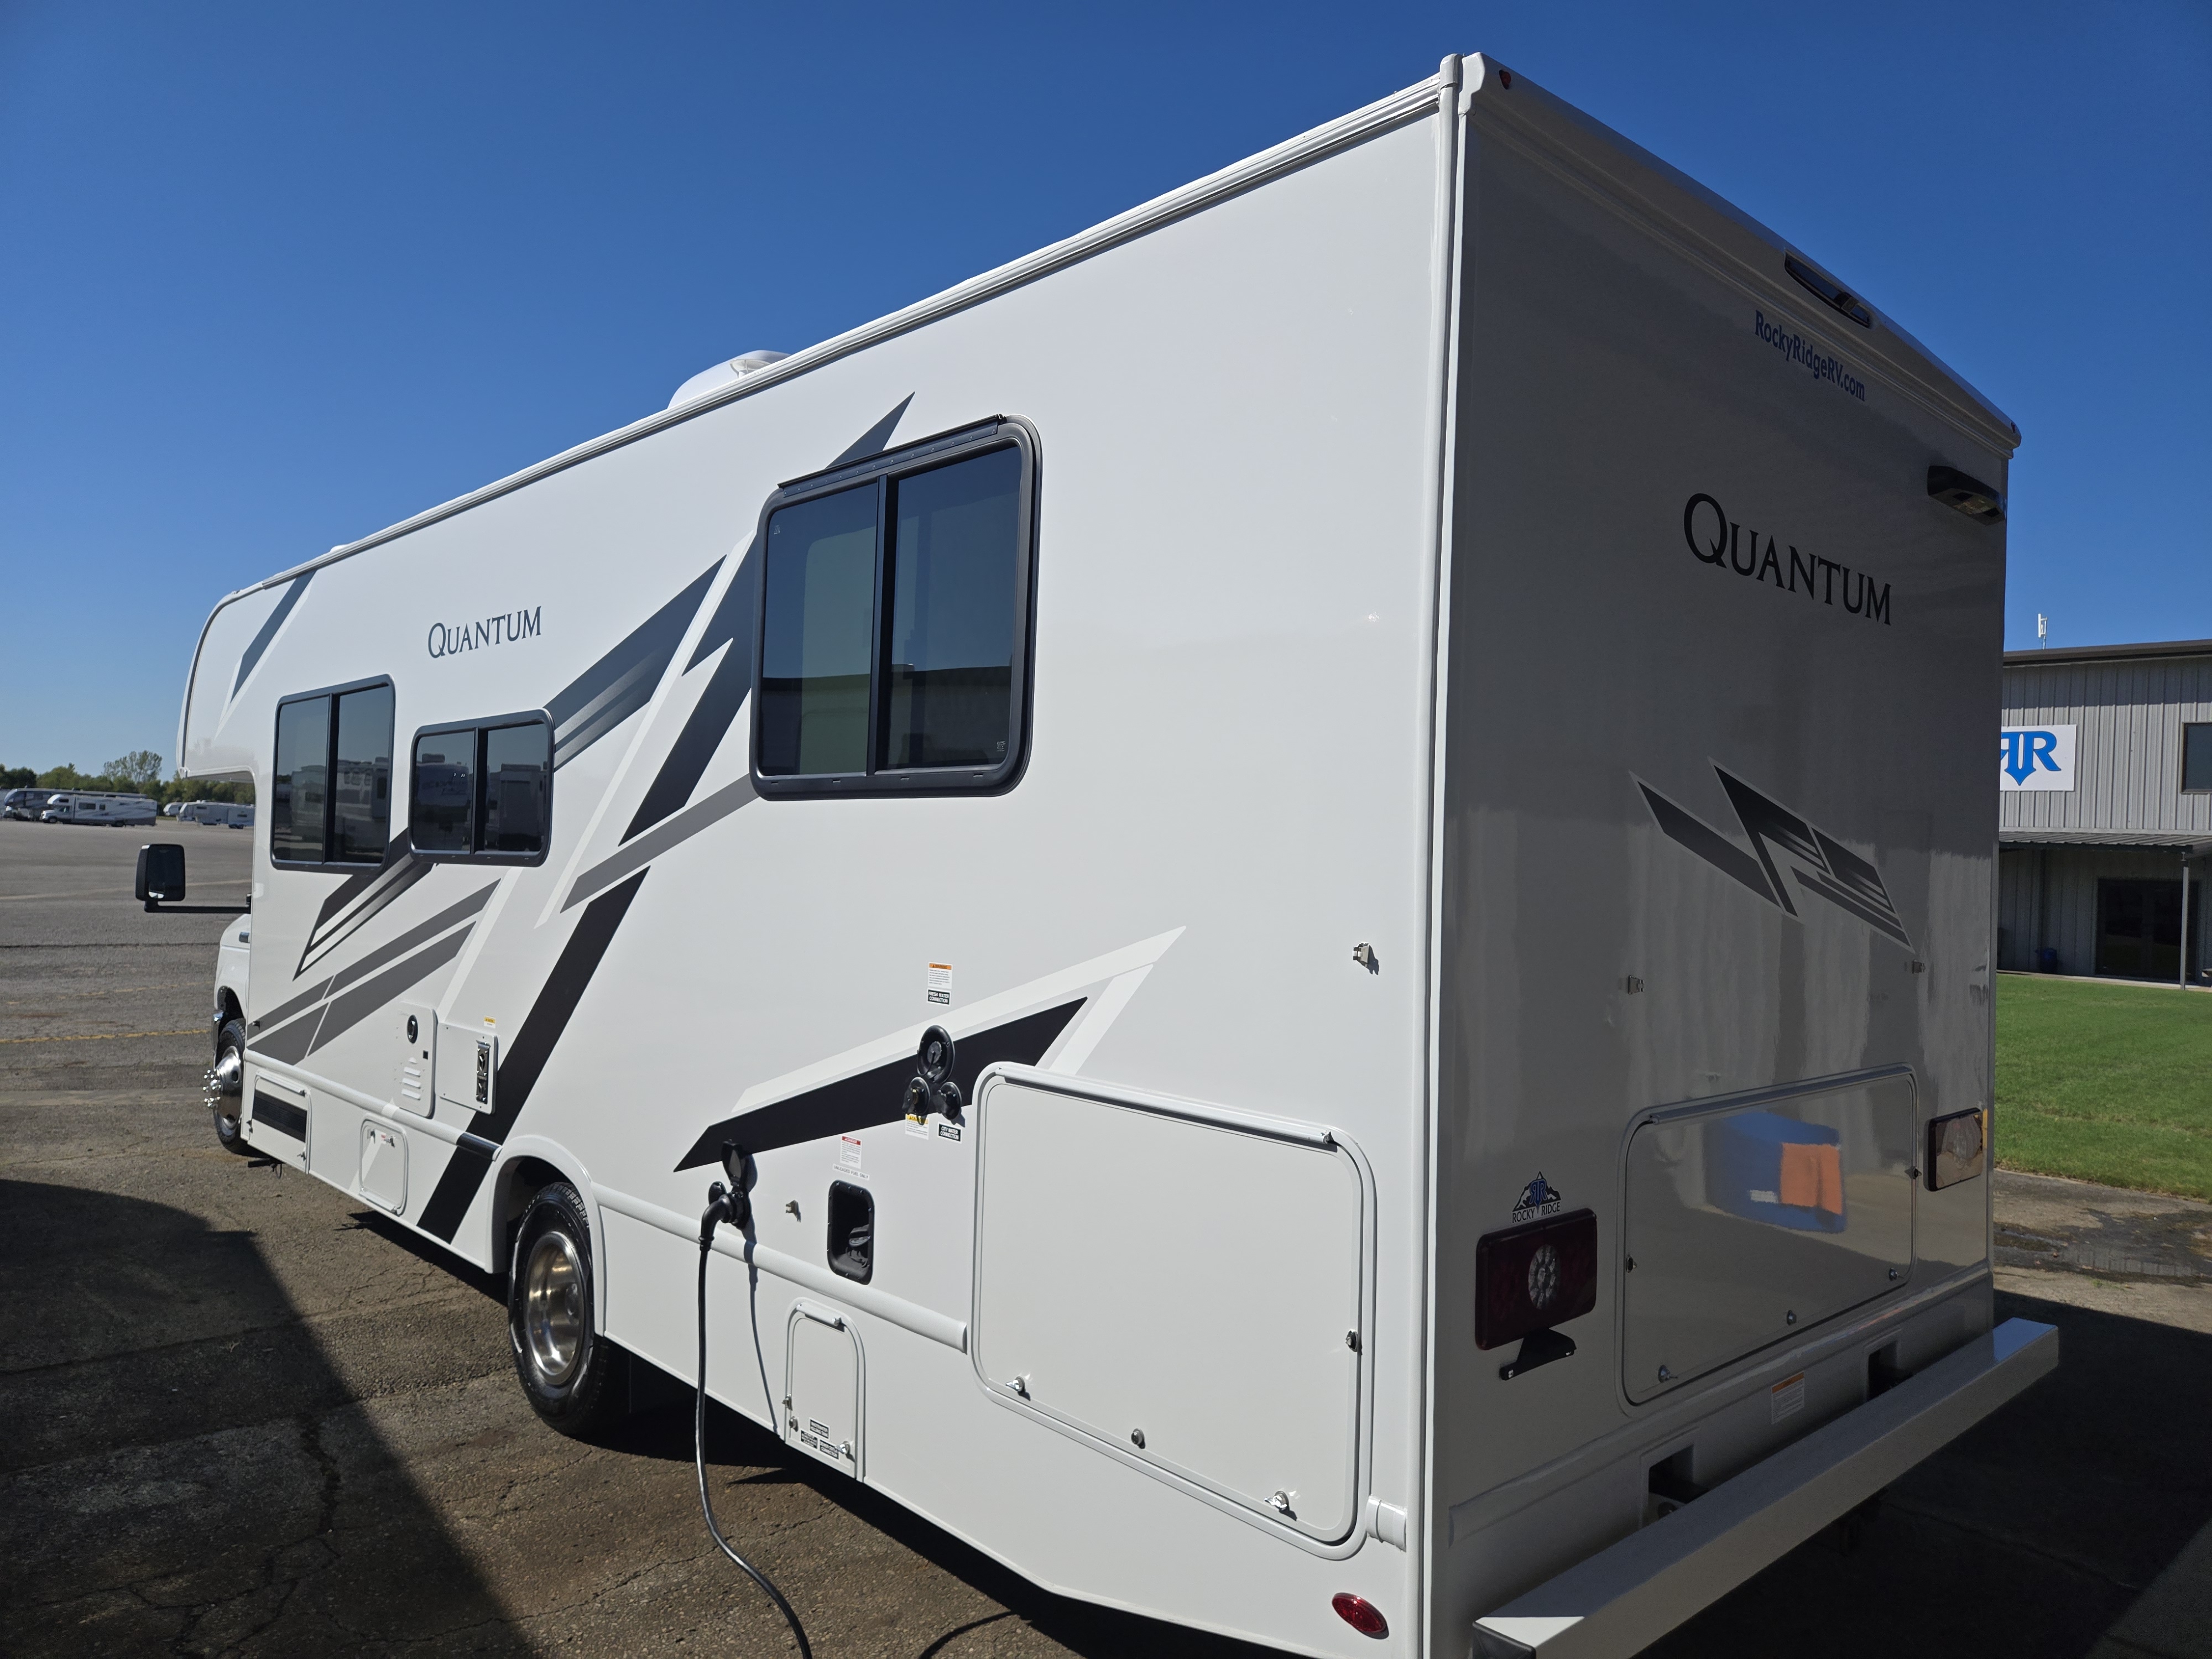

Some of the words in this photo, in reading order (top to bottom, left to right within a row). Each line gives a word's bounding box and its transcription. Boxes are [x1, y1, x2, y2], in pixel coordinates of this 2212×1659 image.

[1755, 310, 1865, 401] RockyRidgeRV.com
[1684, 493, 1891, 626] QUANTUM
[428, 606, 541, 659] QUANTUM
[834, 1165, 851, 1173] UNLEADED
[1512, 1208, 1535, 1223] ROCKY
[1541, 1202, 1561, 1216] RIDGE
